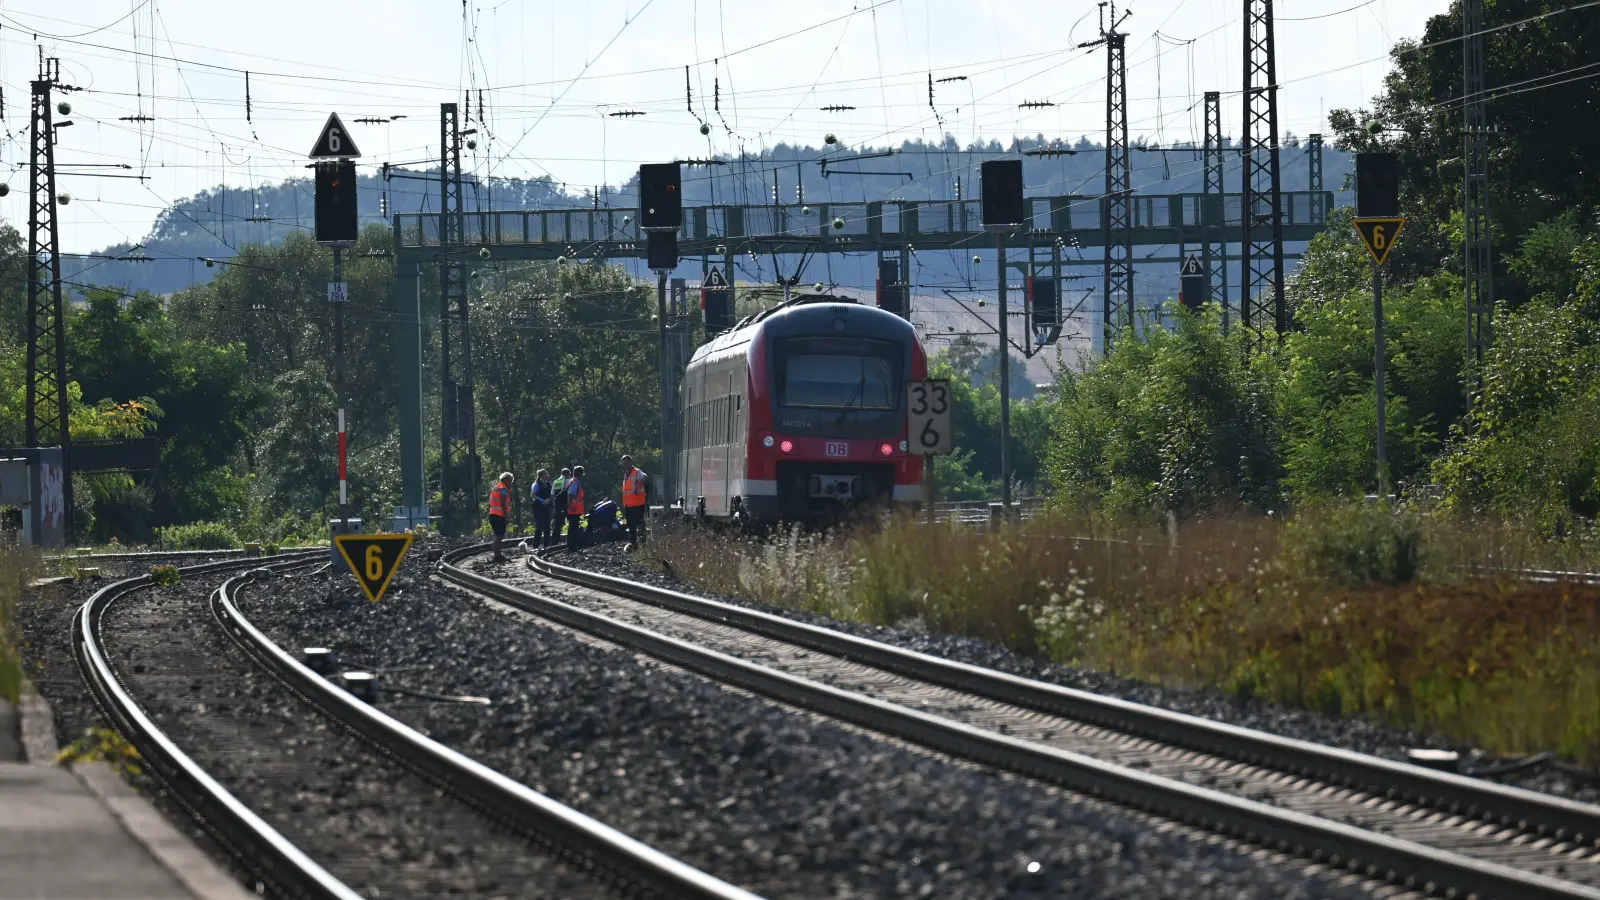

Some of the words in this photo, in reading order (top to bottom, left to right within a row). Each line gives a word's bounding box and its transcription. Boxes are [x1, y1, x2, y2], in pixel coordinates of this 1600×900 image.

[328, 127, 341, 152] 6
[1373, 225, 1385, 249] 6
[711, 271, 719, 285] 6
[1189, 260, 1196, 273] 6
[333, 283, 342, 291] 16
[911, 386, 948, 416] 33
[920, 418, 940, 448] 6
[827, 443, 847, 456] DB
[365, 544, 383, 581] 6
